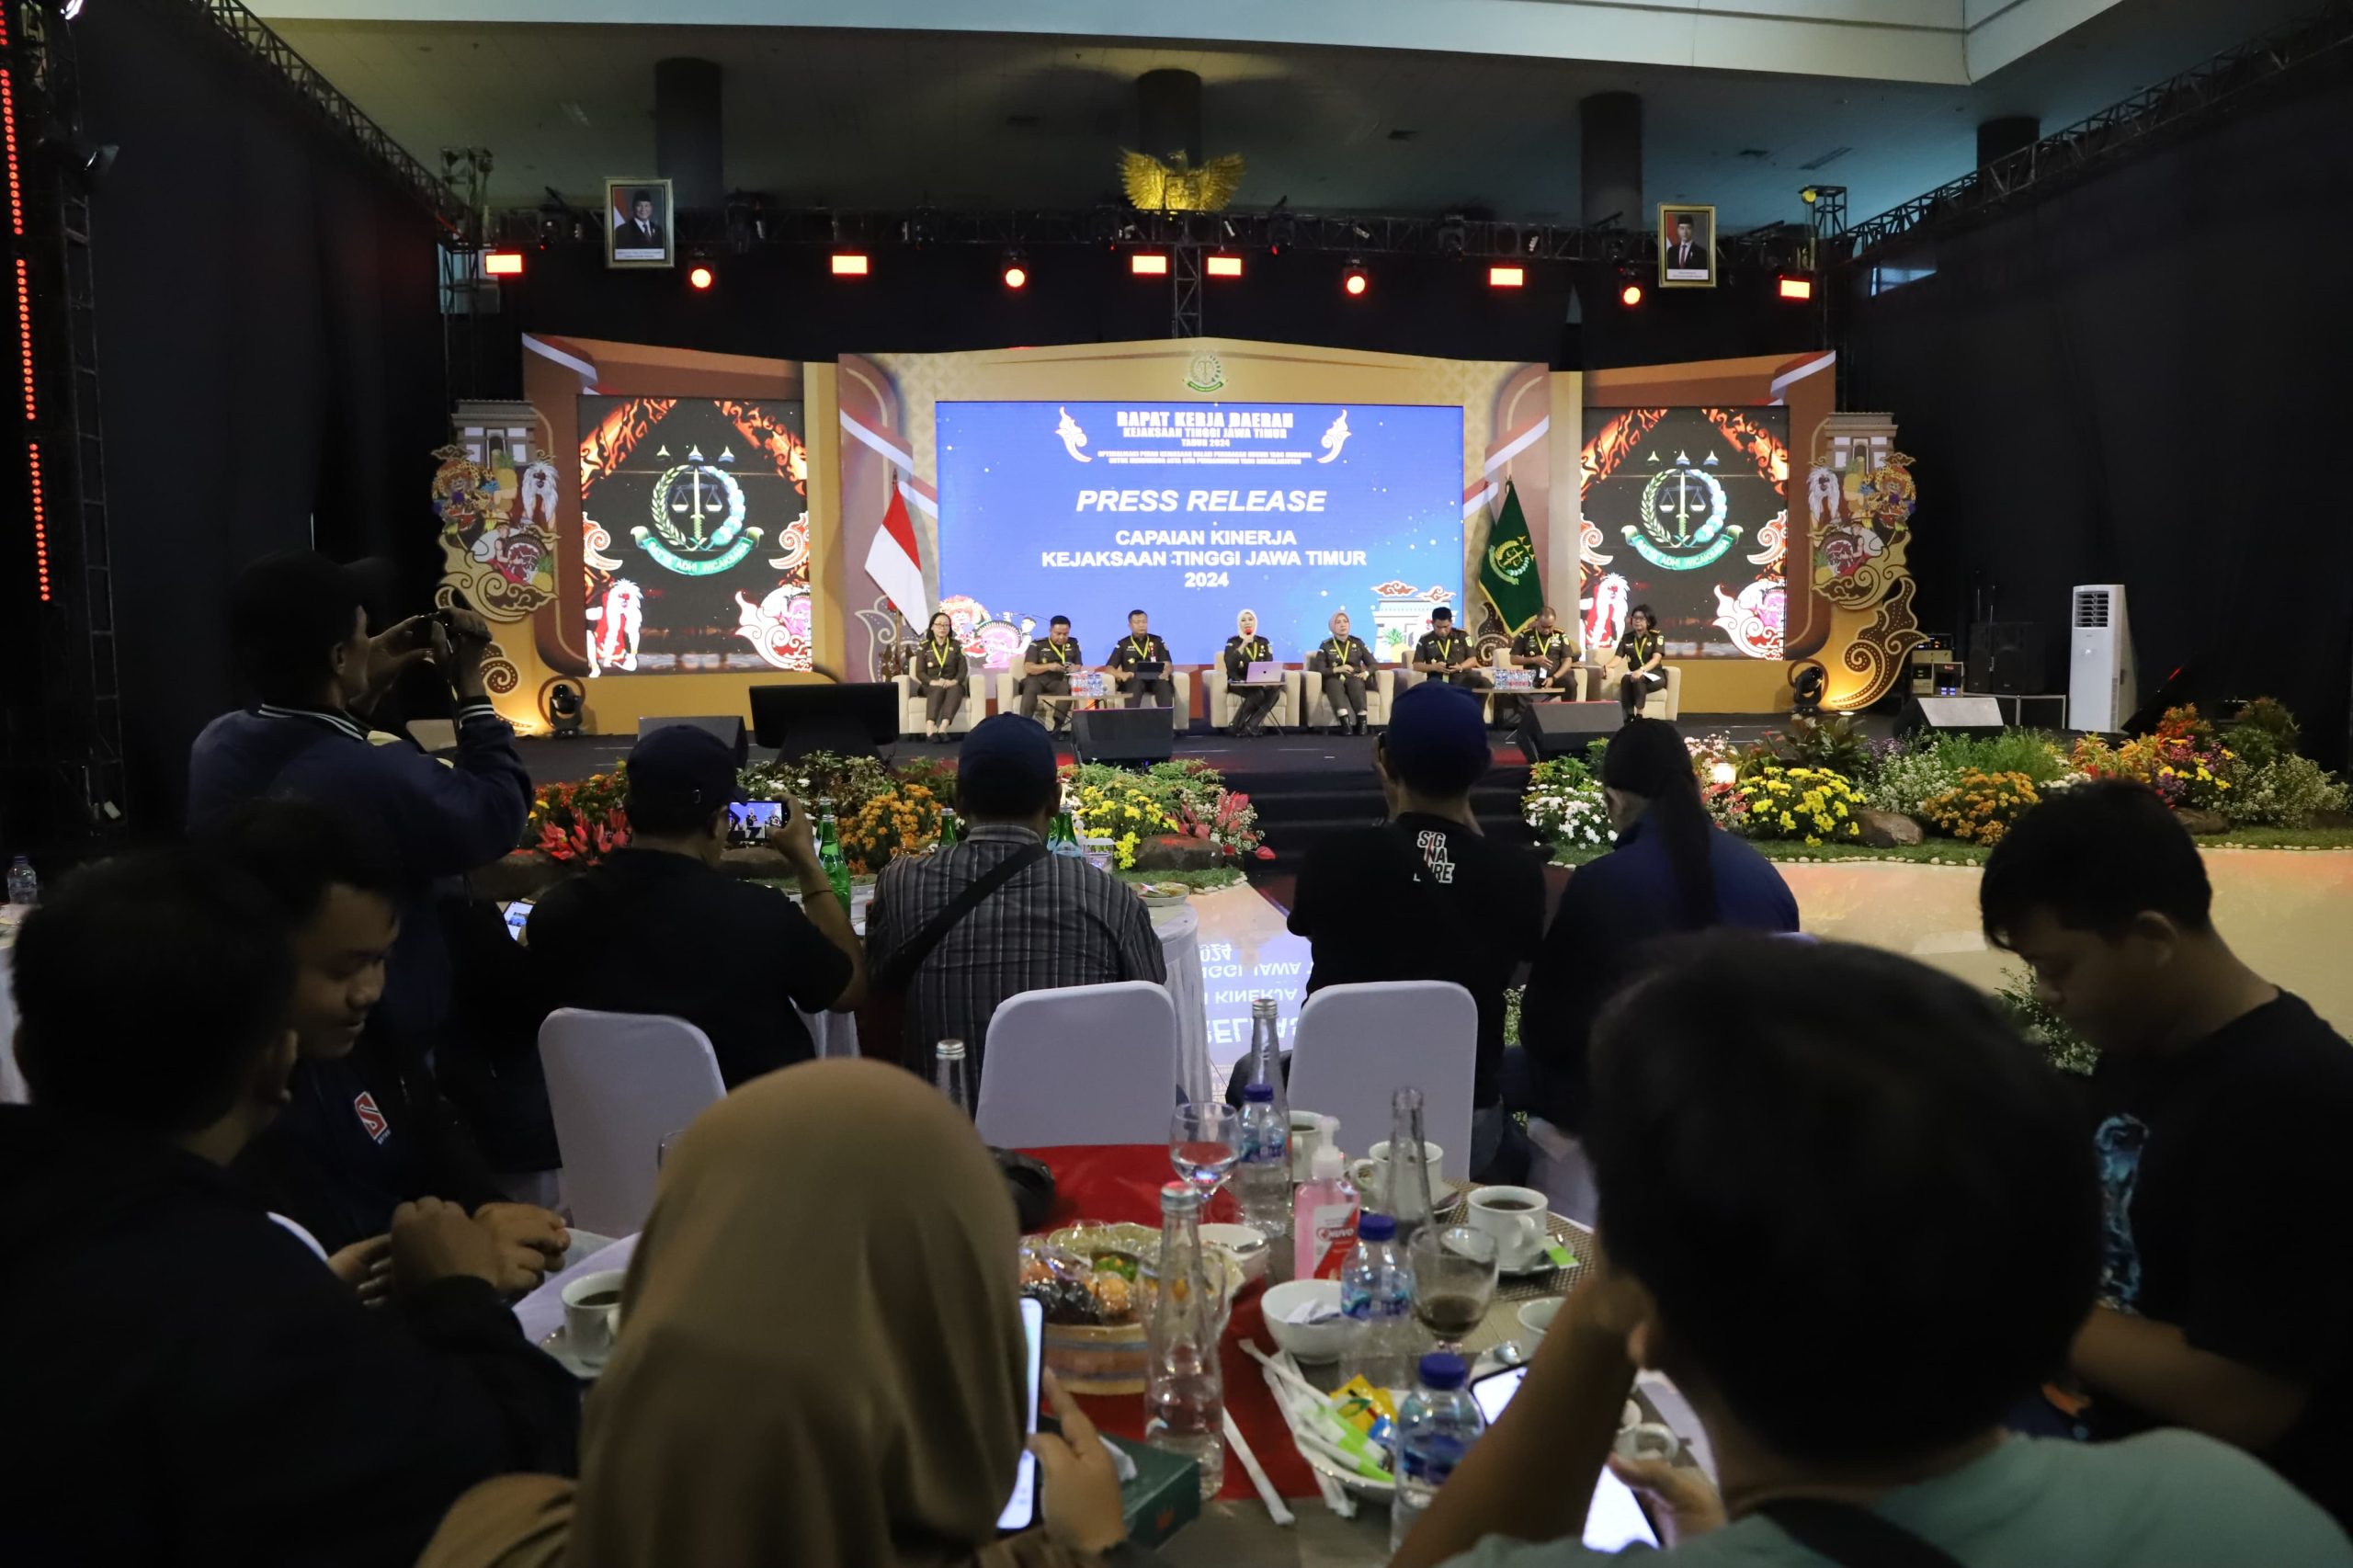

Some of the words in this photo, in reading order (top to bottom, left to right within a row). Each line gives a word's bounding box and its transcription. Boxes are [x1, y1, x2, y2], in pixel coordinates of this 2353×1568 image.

[1117, 411, 1170, 427] RAPAT
[1175, 412, 1225, 427] KERJA
[1229, 412, 1294, 428] DAERAH
[1123, 427, 1183, 437] KEJAKSAAN
[1185, 427, 1222, 438] TINGGI
[1223, 428, 1252, 438] JAWA
[1254, 428, 1287, 439] TIMUR
[1181, 438, 1208, 447] TAHUN
[1210, 438, 1231, 447] 2024
[1076, 490, 1178, 512] PRESS
[1187, 490, 1327, 512] RELEASE
[1115, 530, 1205, 546] CAPAIAN
[1211, 530, 1297, 545] KINERJA
[1041, 551, 1166, 567] KEJAKSAAN
[1172, 551, 1240, 566] TINGGI
[1245, 551, 1302, 566] JAWA
[1305, 551, 1367, 566] TIMUR
[1184, 572, 1230, 587] 2024
[1416, 830, 1446, 848] SIG
